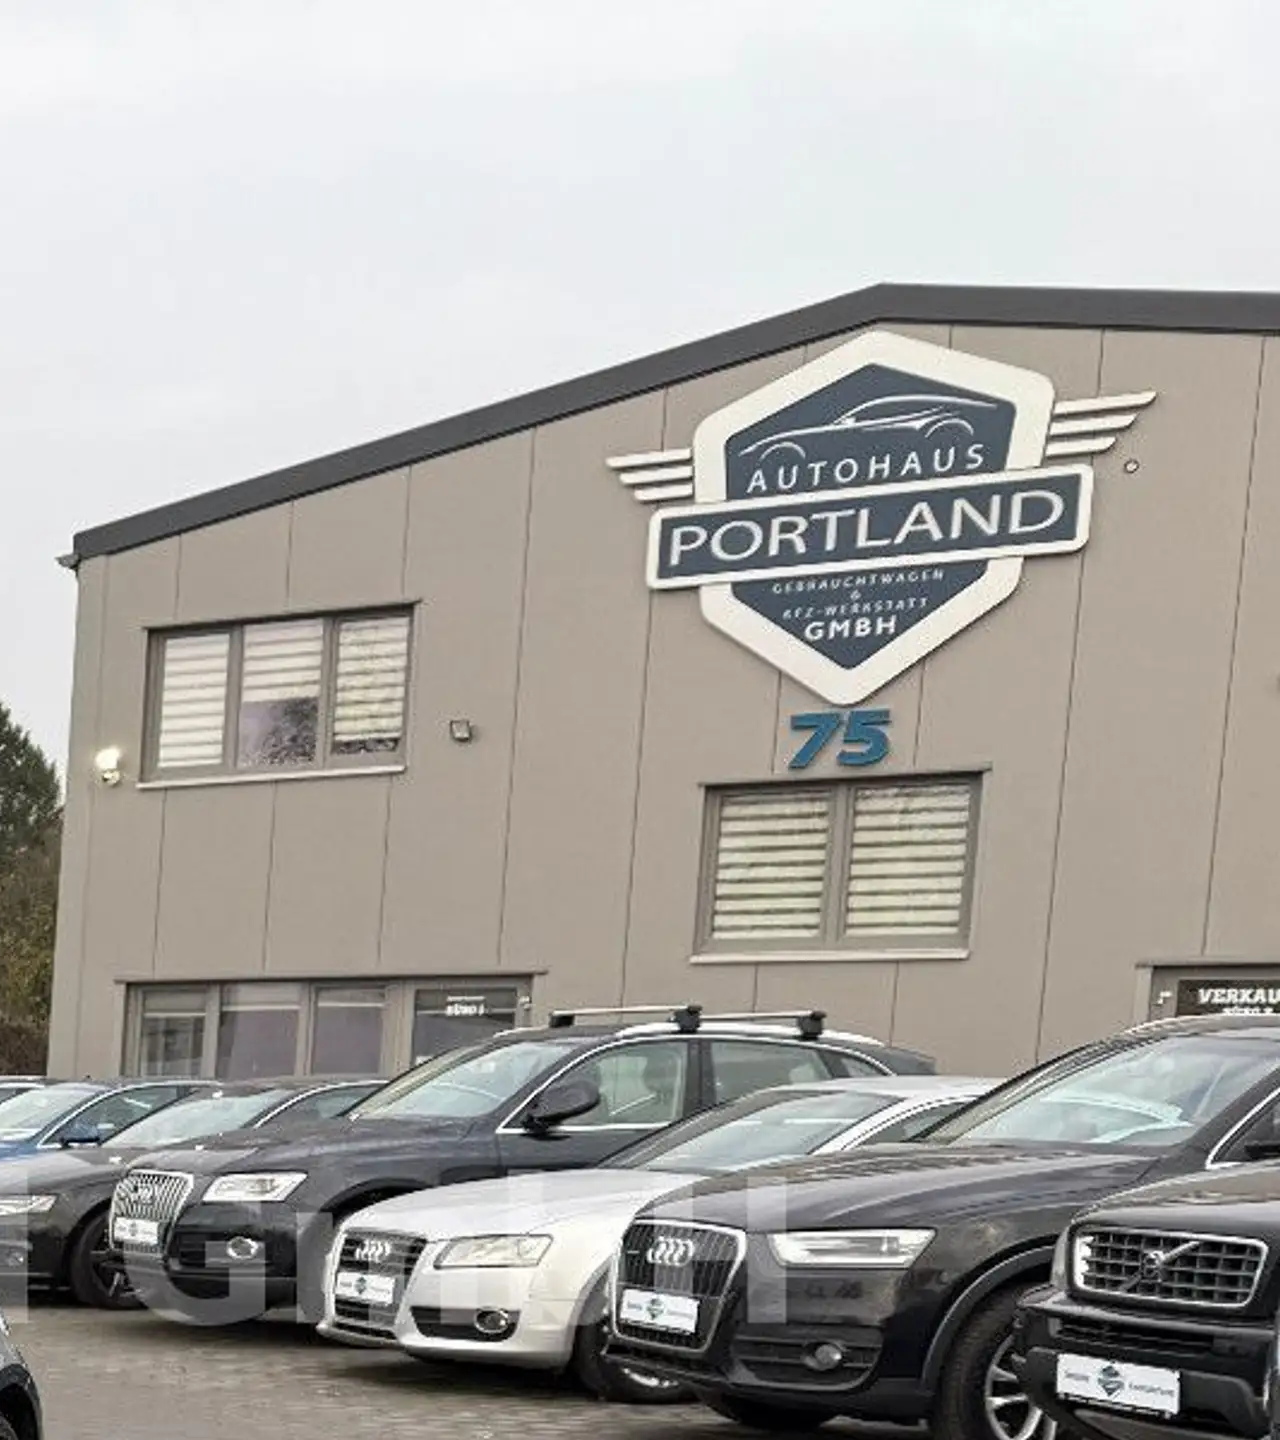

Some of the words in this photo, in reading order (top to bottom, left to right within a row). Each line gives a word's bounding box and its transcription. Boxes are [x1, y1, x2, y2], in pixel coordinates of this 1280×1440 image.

[746, 443, 986, 495] AUTOHAUS
[668, 489, 1066, 567] PORTLAND
[772, 568, 944, 595] GEBRAUCHTWAGEN
[804, 614, 898, 641] GMBH
[787, 710, 892, 770] 75
